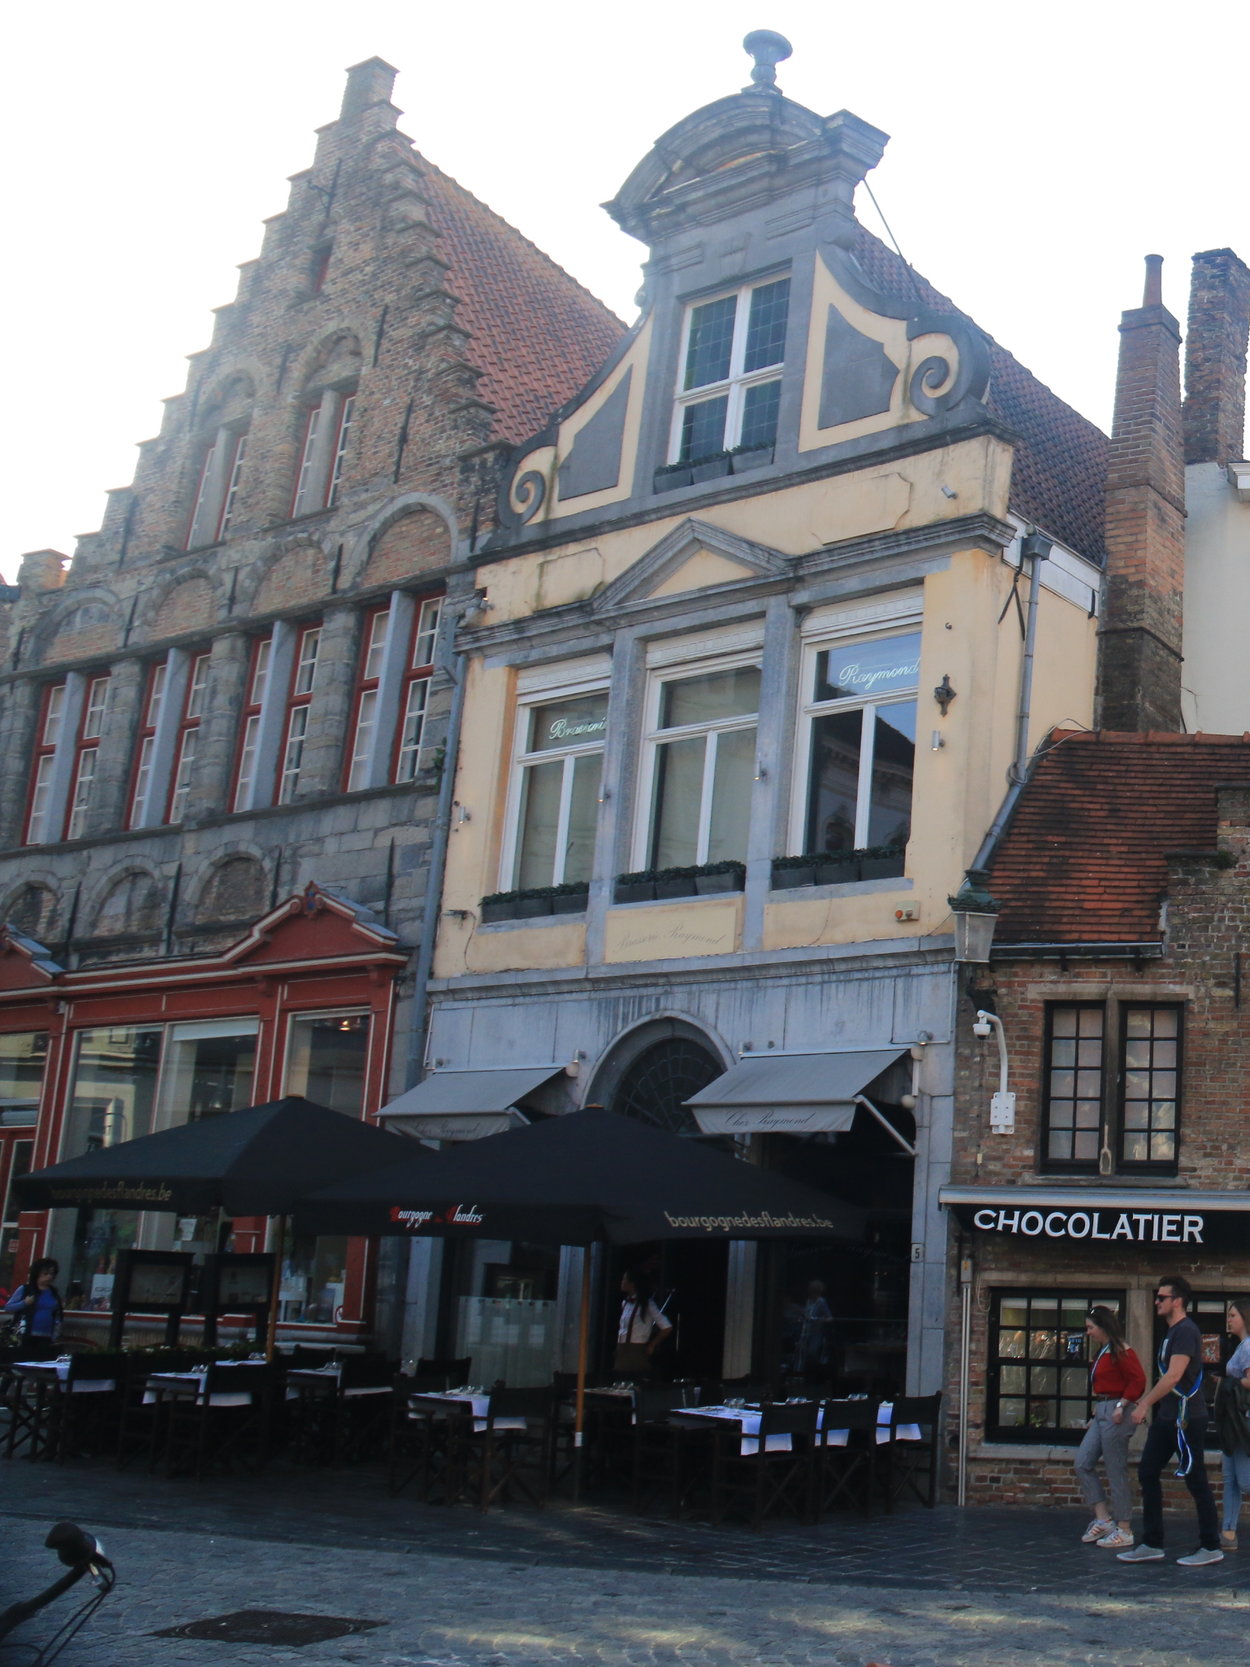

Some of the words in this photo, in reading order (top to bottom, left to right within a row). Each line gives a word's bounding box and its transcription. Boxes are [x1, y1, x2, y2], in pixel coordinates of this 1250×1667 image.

[838, 657, 921, 690] Raymond
[757, 1111, 817, 1130] Raymond
[663, 1211, 835, 1232] bourgognedesflandres.be
[973, 1208, 1205, 1244] CHOCOLATIER
